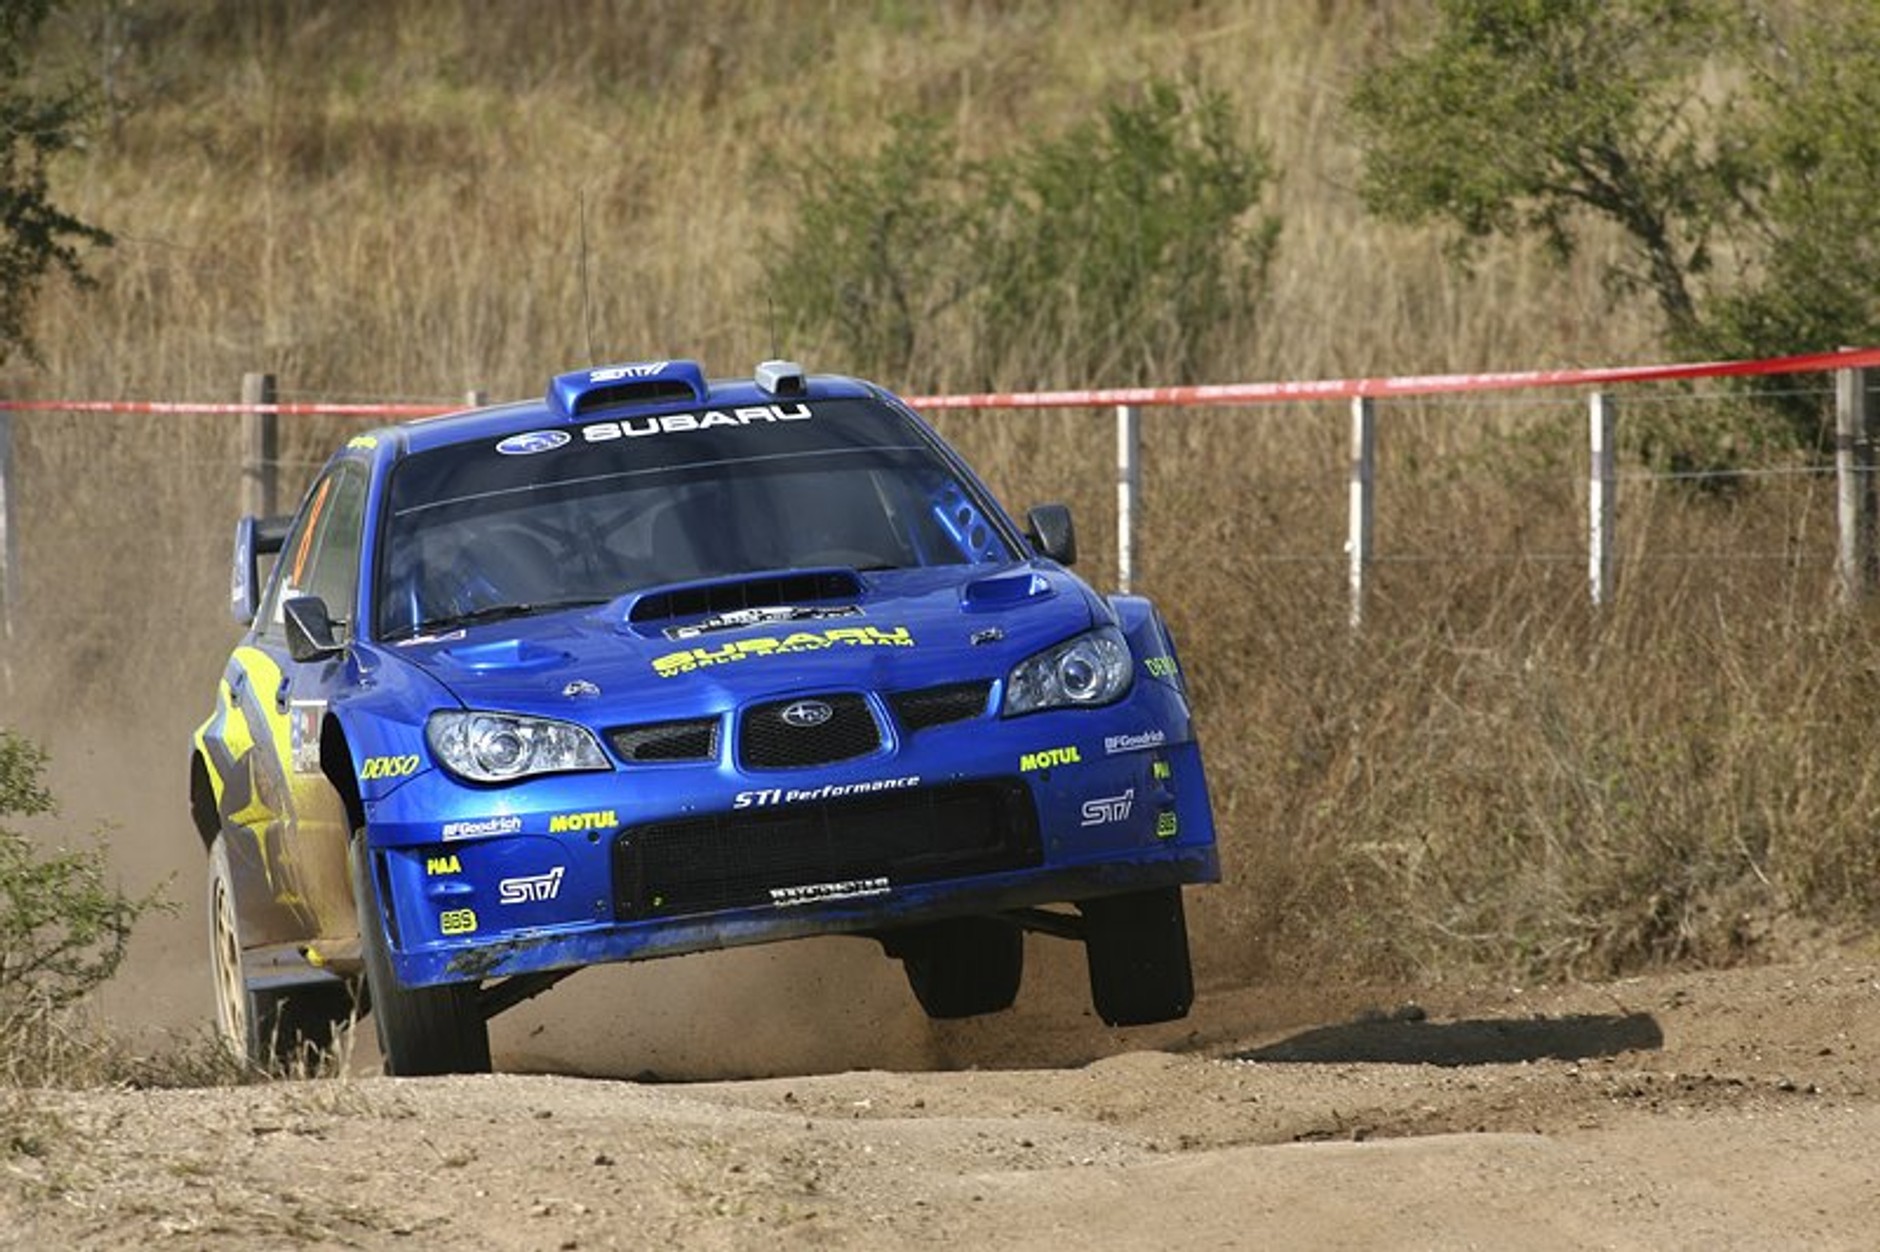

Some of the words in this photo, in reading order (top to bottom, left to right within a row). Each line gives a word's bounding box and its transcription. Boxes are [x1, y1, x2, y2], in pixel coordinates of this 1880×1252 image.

[582, 404, 812, 442] SUBARU
[652, 626, 909, 672] SUBARU
[658, 652, 746, 677] WORLD
[1104, 730, 1165, 755] BFGoodrich
[360, 755, 419, 779] DENSO
[1019, 746, 1081, 772] MOTUL
[733, 789, 782, 809] STI
[785, 775, 920, 803] Performance
[442, 816, 522, 842] BFGoodrich
[549, 811, 618, 832] MOTUL
